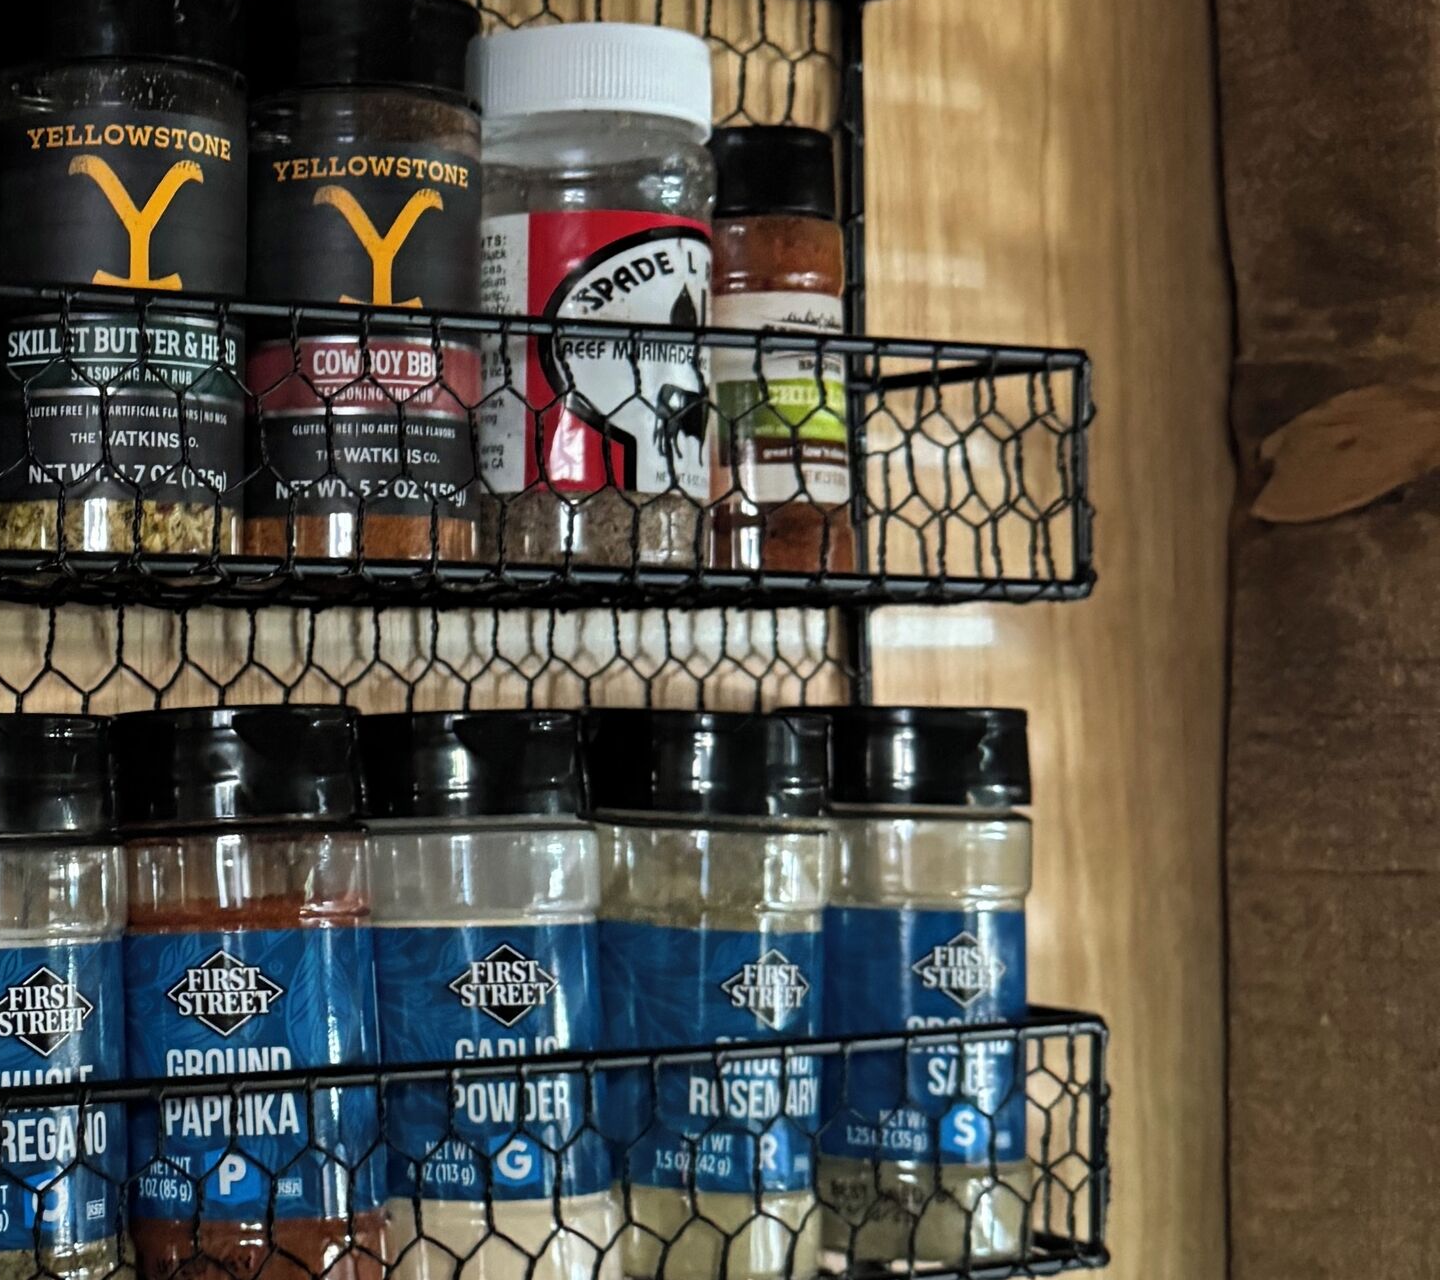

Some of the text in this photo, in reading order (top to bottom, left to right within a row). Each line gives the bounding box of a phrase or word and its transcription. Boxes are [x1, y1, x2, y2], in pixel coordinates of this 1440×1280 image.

[27, 124, 232, 161] YELLOWSTONE
[273, 156, 470, 190] YELLOWSTONE
[583, 251, 675, 312] SPADE
[184, 332, 199, 359] &
[562, 340, 606, 360] BEEF
[171, 370, 193, 385] RUB
[60, 405, 160, 418] FREE ARTIFICIAL
[70, 432, 96, 444] THE
[361, 423, 457, 440] NO FLAVORS
[423, 451, 442, 464] CO.
[394, 480, 420, 498] OZ
[186, 967, 260, 993] FIRST
[470, 960, 540, 985] FIRST
[743, 964, 799, 987] FIRST
[7, 983, 78, 1013] FIRST
[177, 989, 273, 1017] STREET
[460, 981, 550, 1008] STREET
[731, 984, 806, 1010] STREET
[165, 1092, 301, 1138] PAPRIKA
[846, 1125, 871, 1145] 1.25
[953, 1109, 977, 1147] S
[452, 1140, 474, 1160] WT
[711, 1134, 734, 1153] WT
[759, 1134, 779, 1171] R
[496, 1138, 533, 1180] G
[655, 1150, 672, 1169] 1.5
[218, 1154, 247, 1196] P
[146, 1178, 158, 1198] OZ
